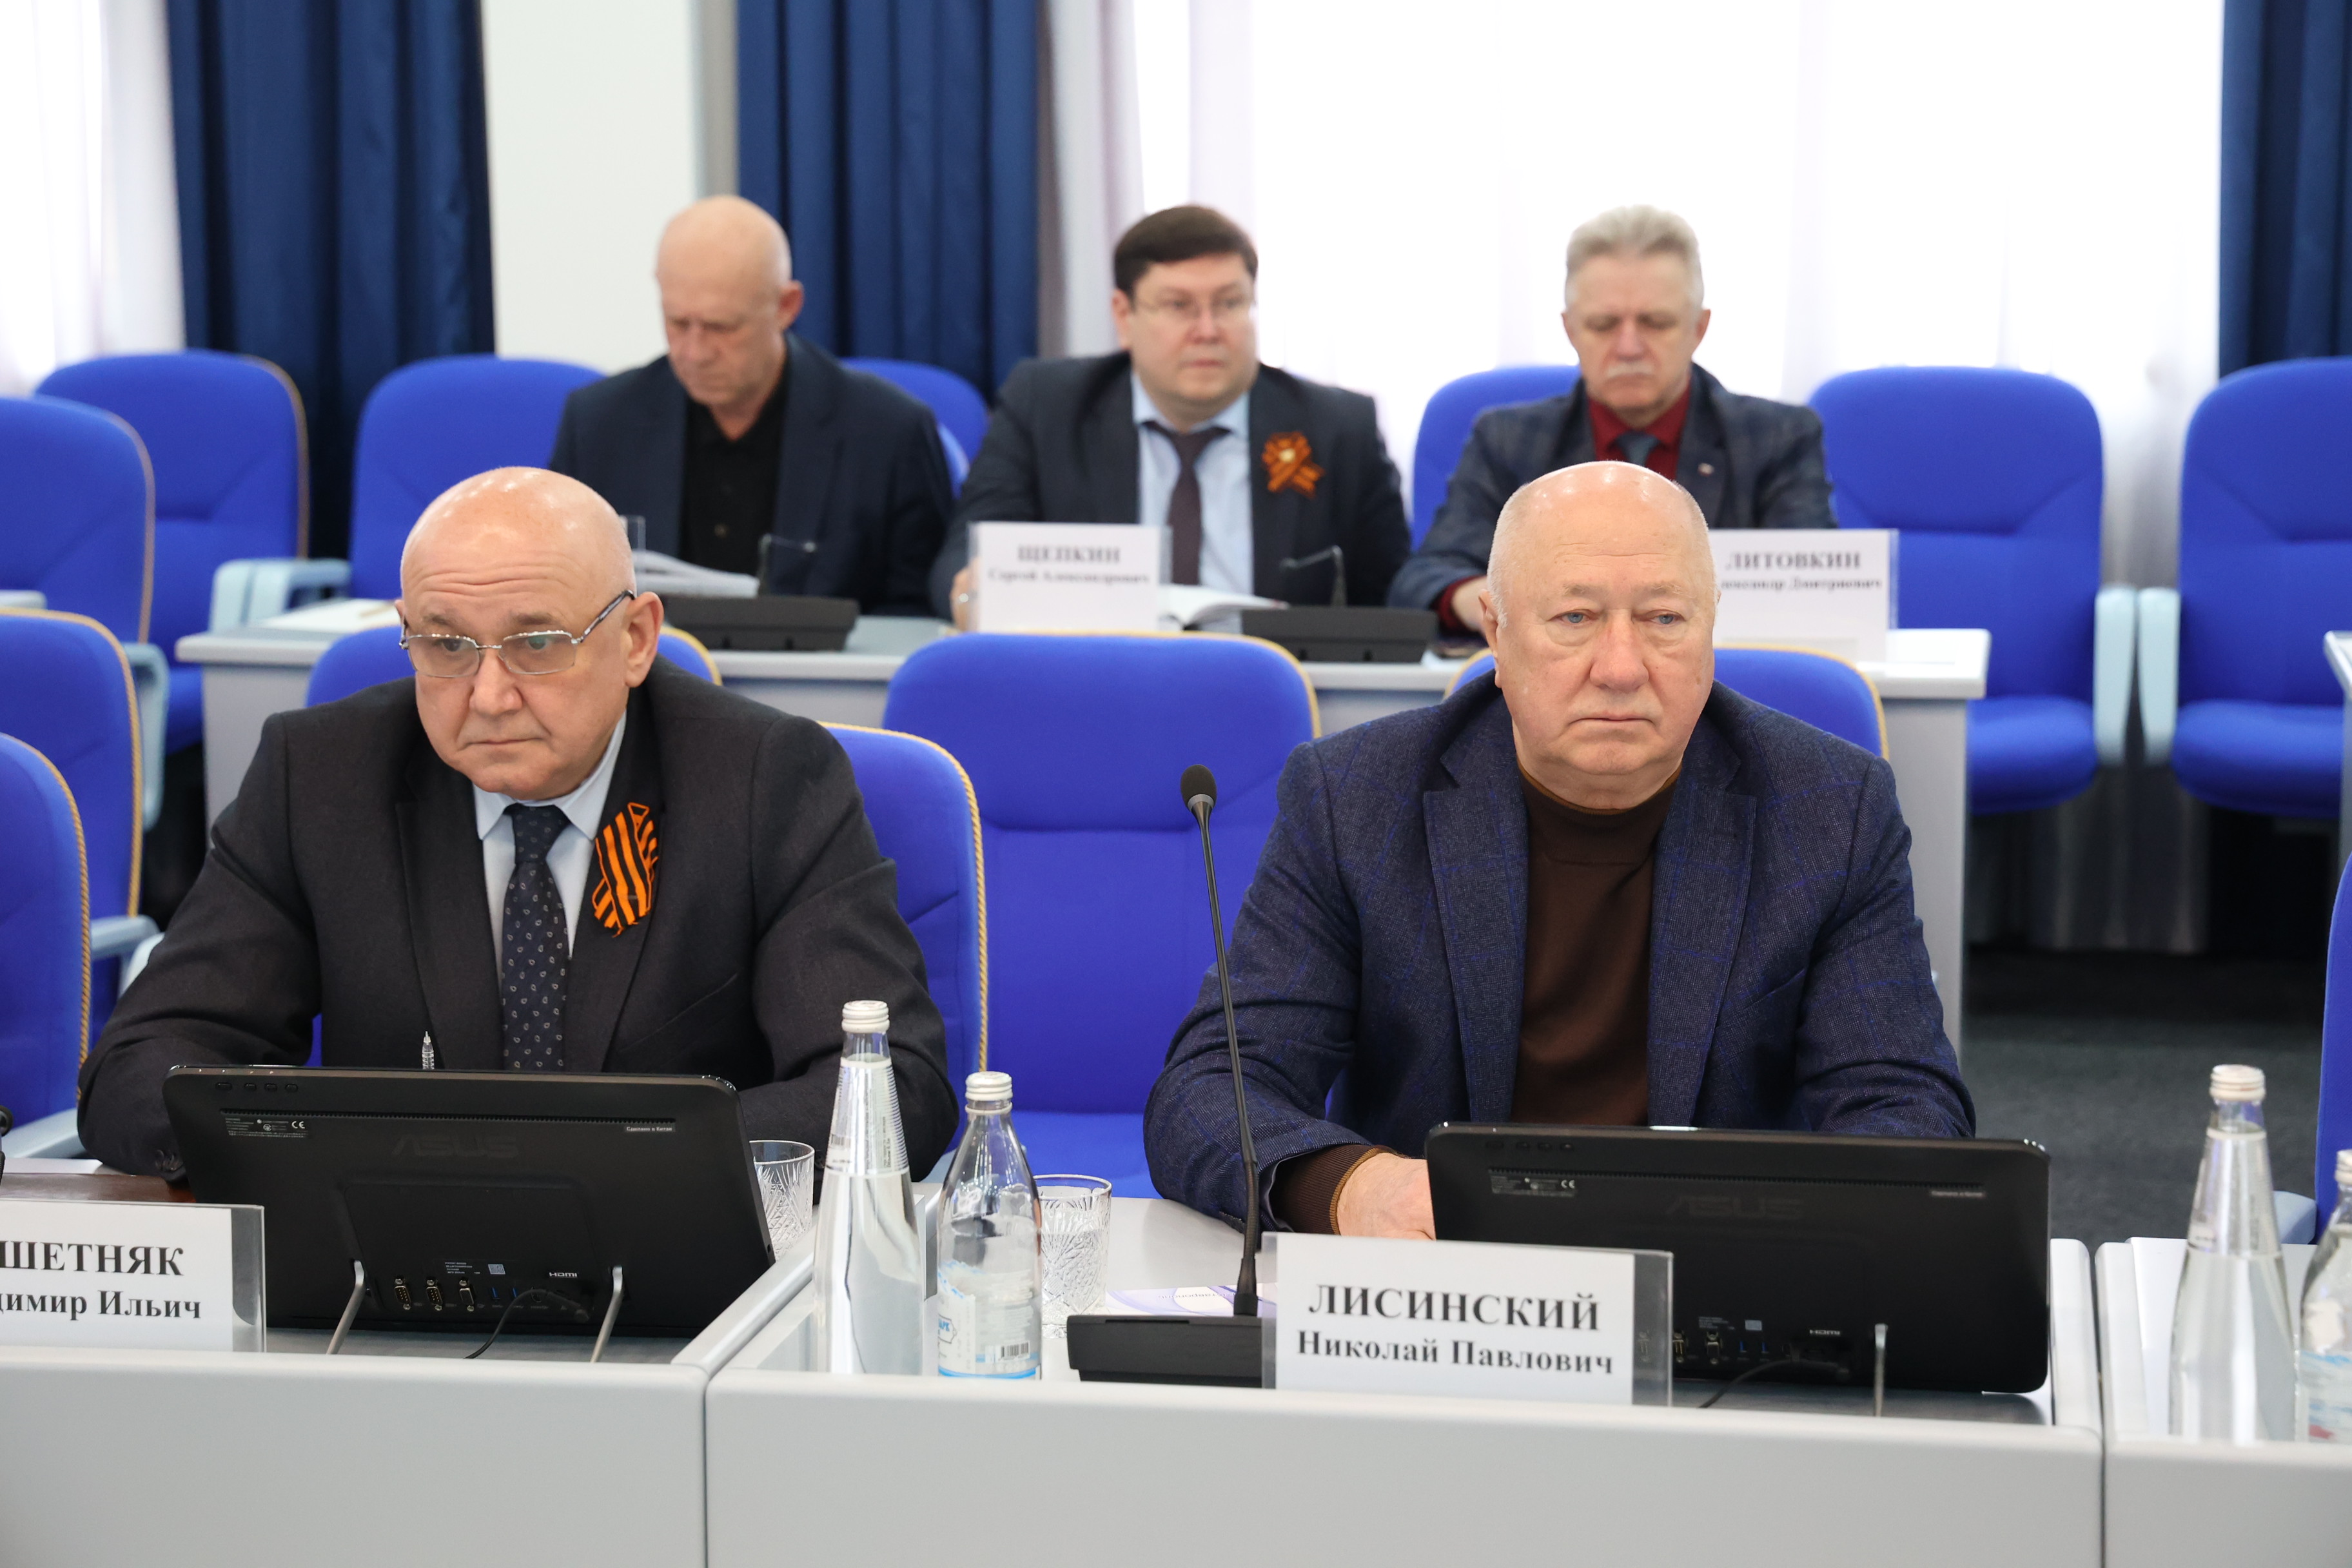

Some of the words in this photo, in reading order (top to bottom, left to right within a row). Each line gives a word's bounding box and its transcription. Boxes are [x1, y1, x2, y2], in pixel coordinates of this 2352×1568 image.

[1725, 551, 1861, 571] ЛИТОВКИН
[0, 1293, 87, 1321] имир
[98, 1290, 201, 1318] Ильич
[1308, 1284, 1602, 1330] ЛИСИНСКИЙ
[1297, 1330, 1438, 1362] Николай
[1451, 1340, 1612, 1374] Павлович
